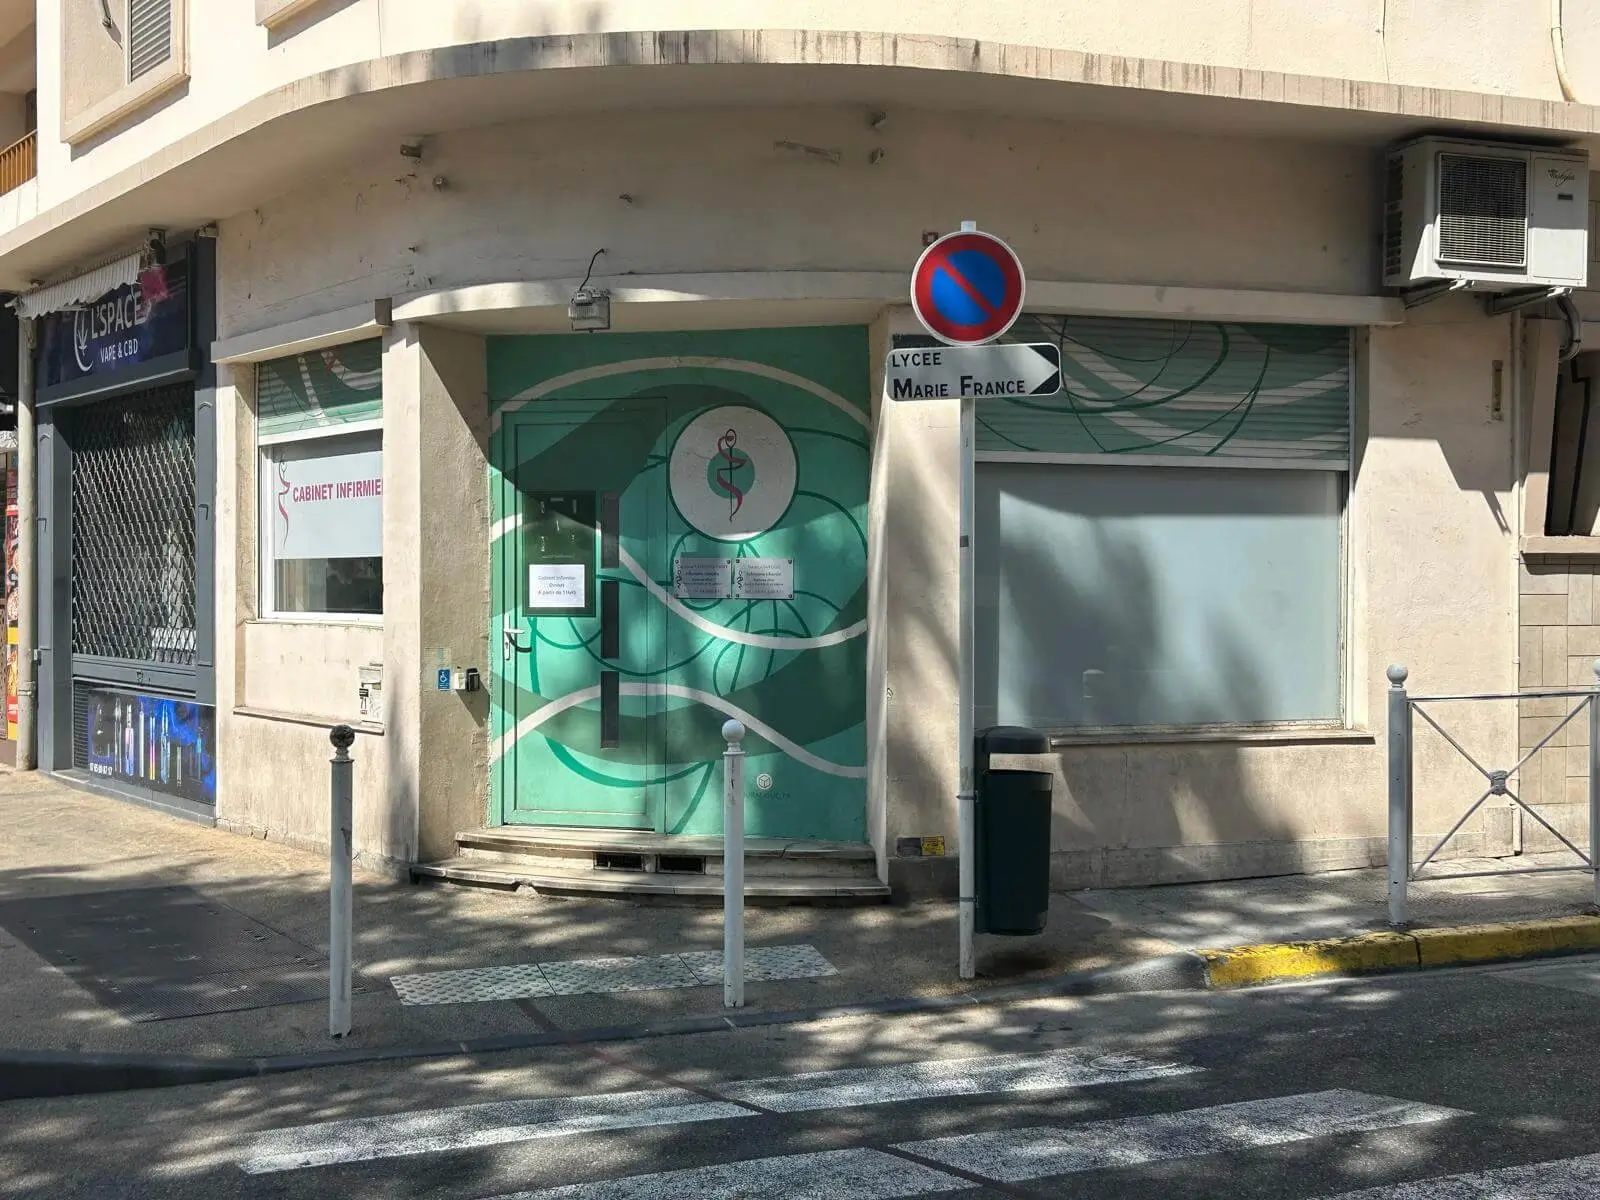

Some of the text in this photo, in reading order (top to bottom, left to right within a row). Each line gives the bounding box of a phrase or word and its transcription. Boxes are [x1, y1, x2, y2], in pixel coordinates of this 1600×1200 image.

[100, 338, 139, 363] VAPE & CBD
[892, 352, 942, 368] LYCEE
[293, 478, 383, 503] CABINET INFIRMIE
